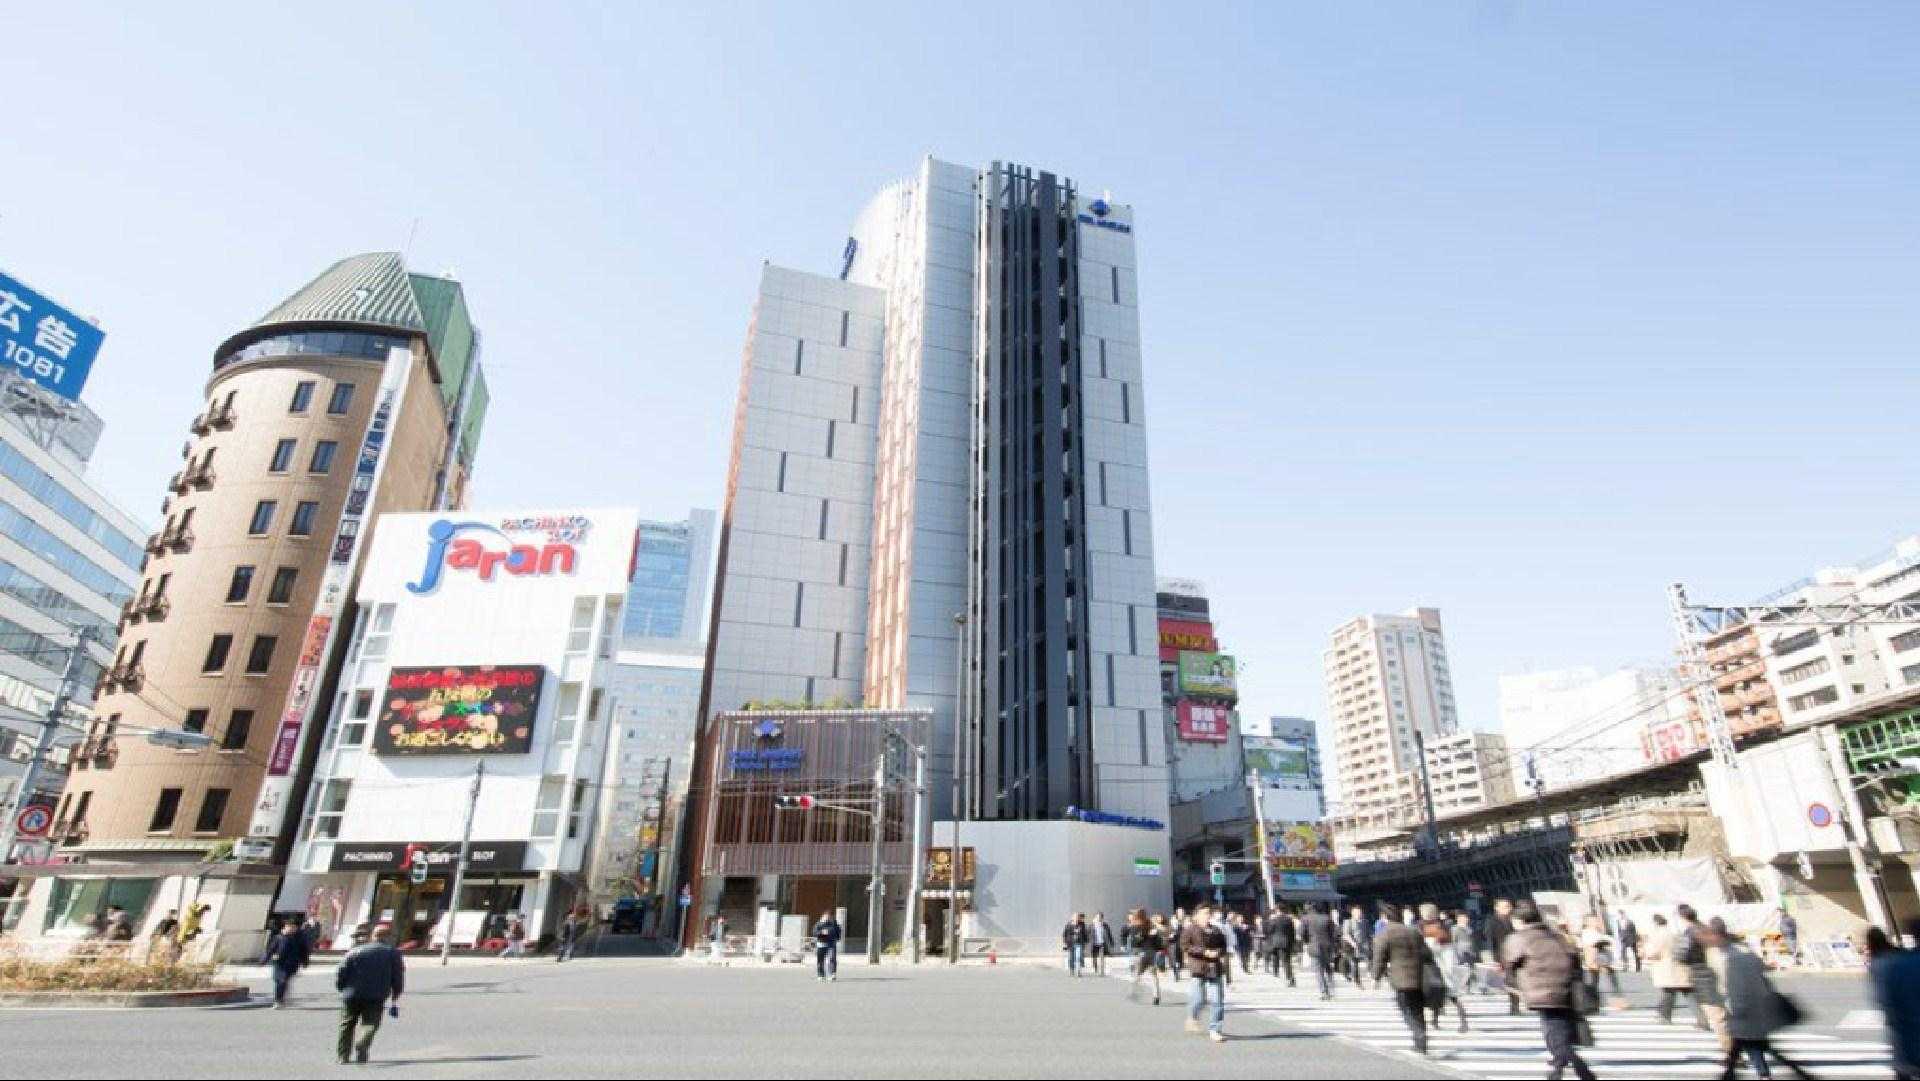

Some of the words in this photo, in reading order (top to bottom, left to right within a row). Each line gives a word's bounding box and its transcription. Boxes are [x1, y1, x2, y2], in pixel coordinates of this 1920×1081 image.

[0, 290, 77, 361] 広告
[5, 340, 65, 384] 1081
[406, 519, 576, 593] jaran
[398, 842, 450, 871] jaan
